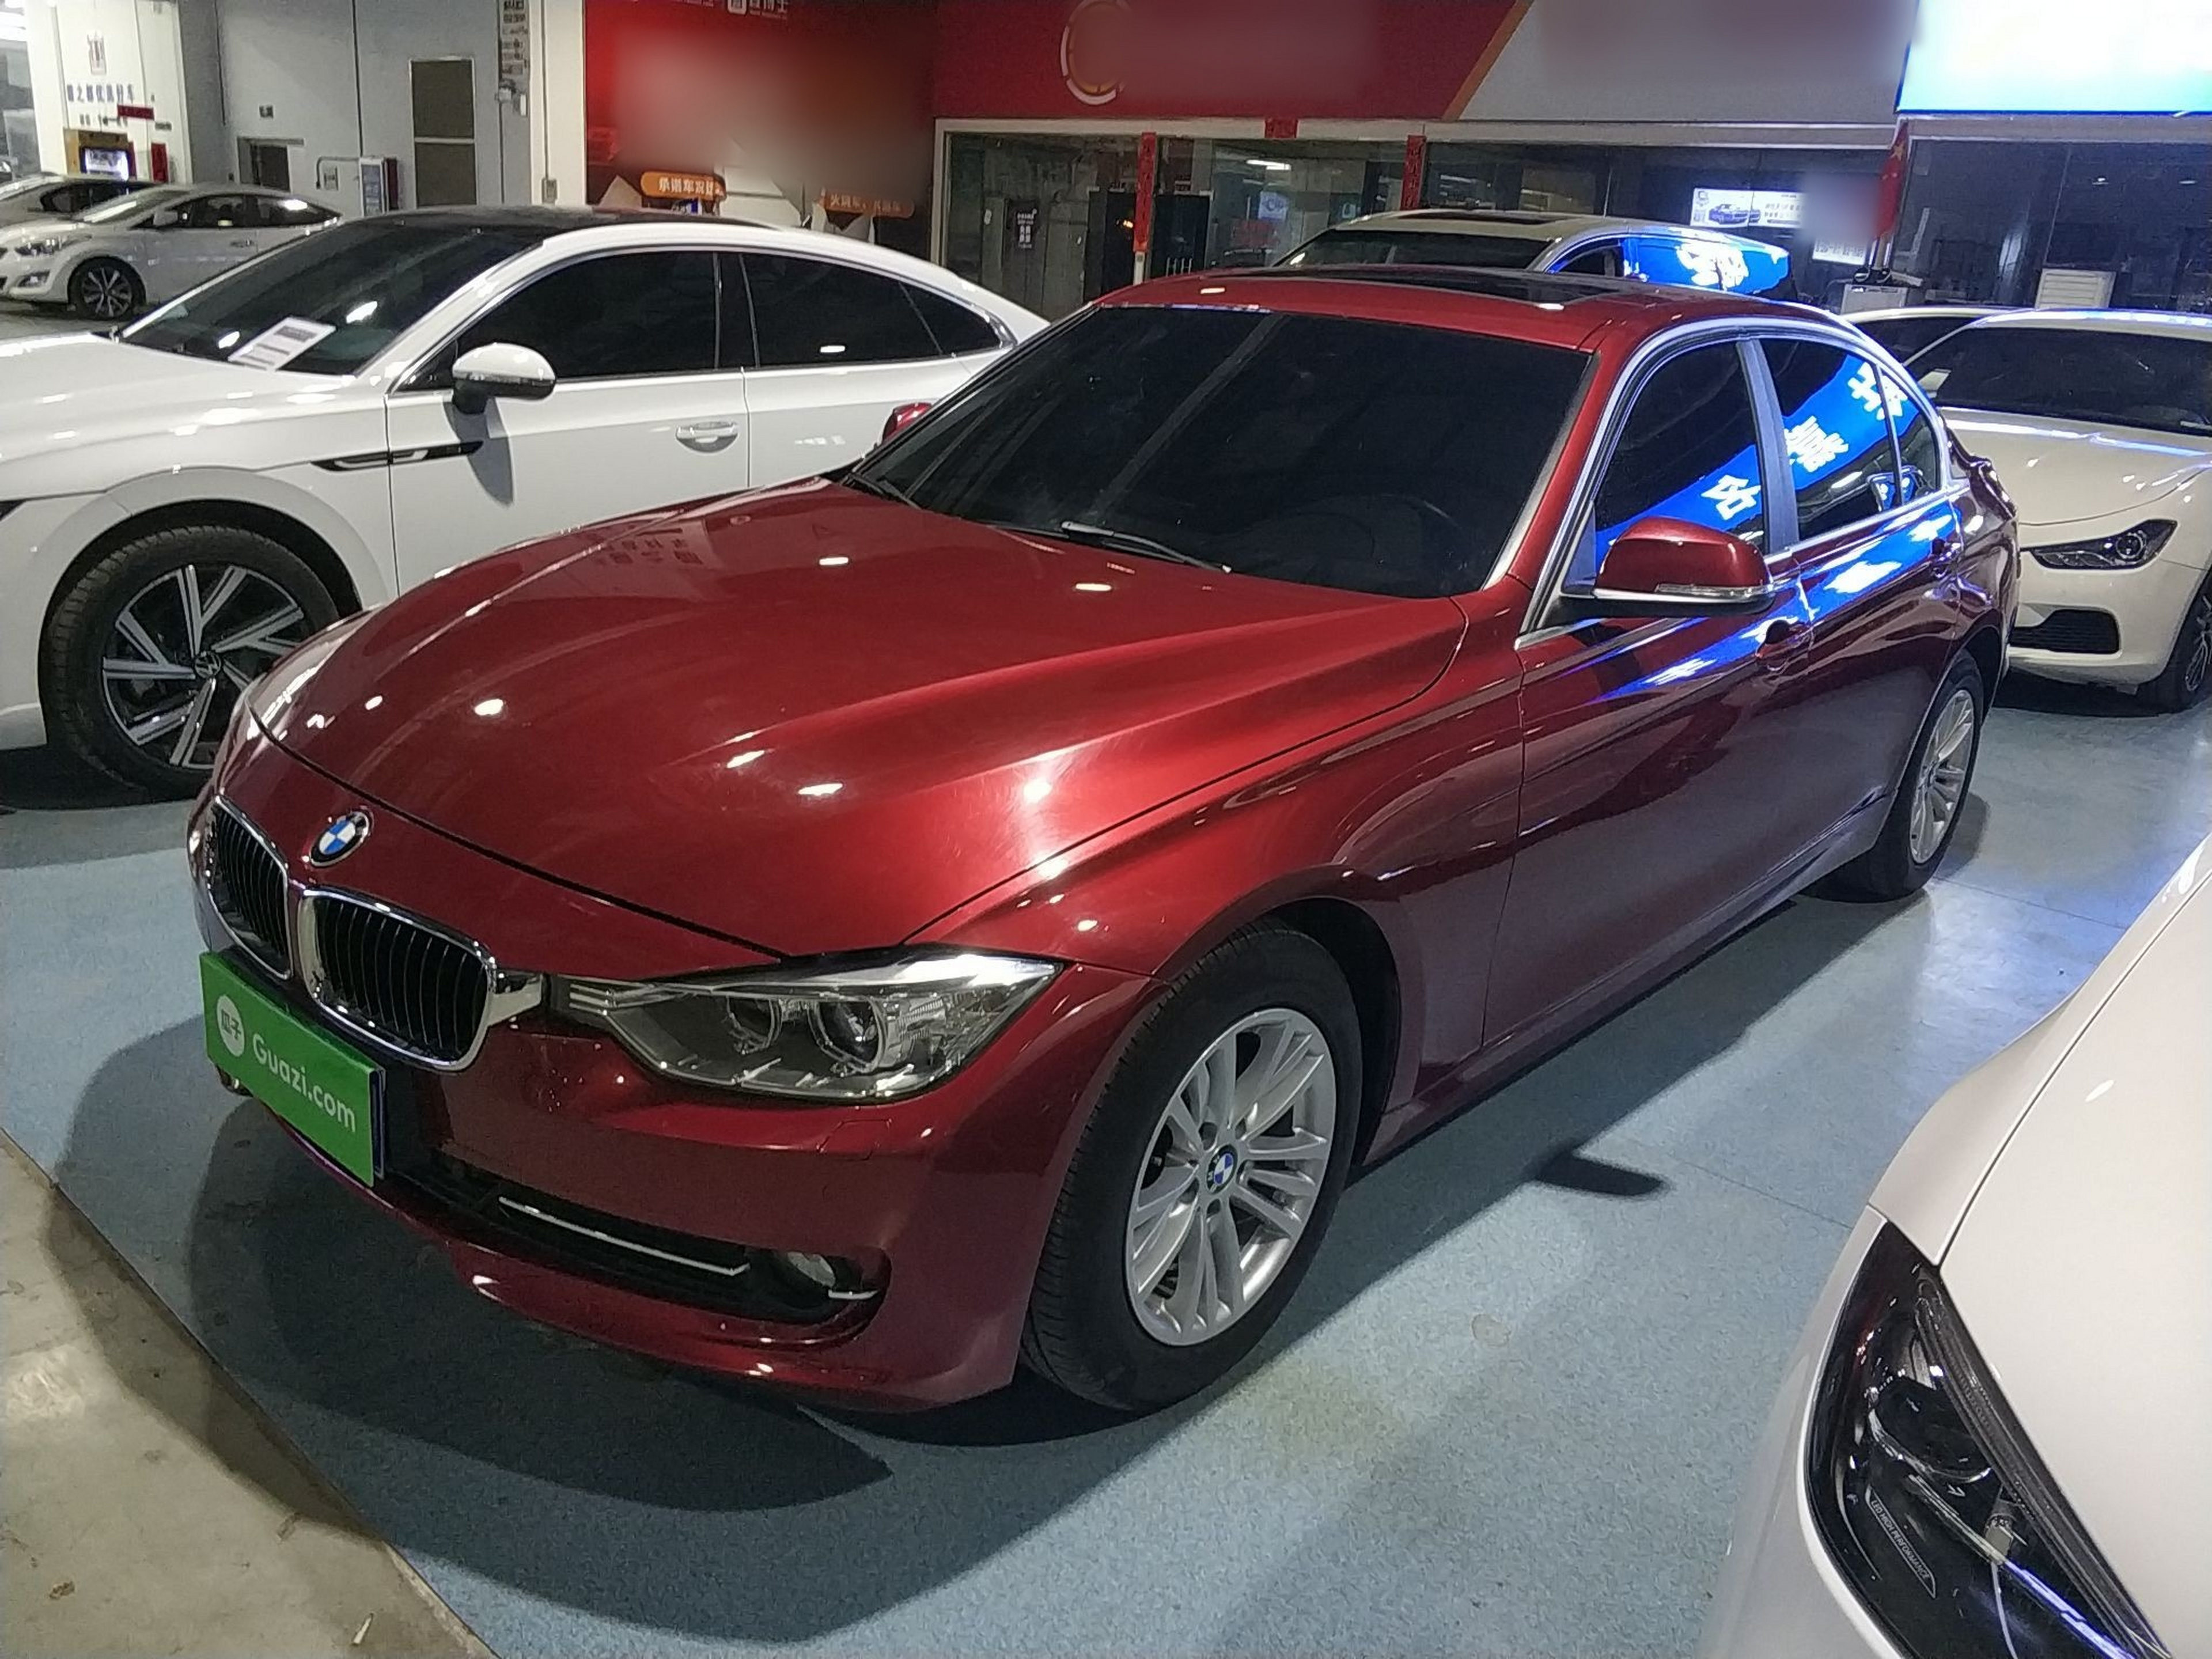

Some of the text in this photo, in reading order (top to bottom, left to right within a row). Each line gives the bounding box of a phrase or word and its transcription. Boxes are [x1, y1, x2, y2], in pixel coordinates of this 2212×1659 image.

[252, 1033, 356, 1133] Guazi.com
[1871, 1501, 1930, 1579] LED HIGH PERFORMANCE
